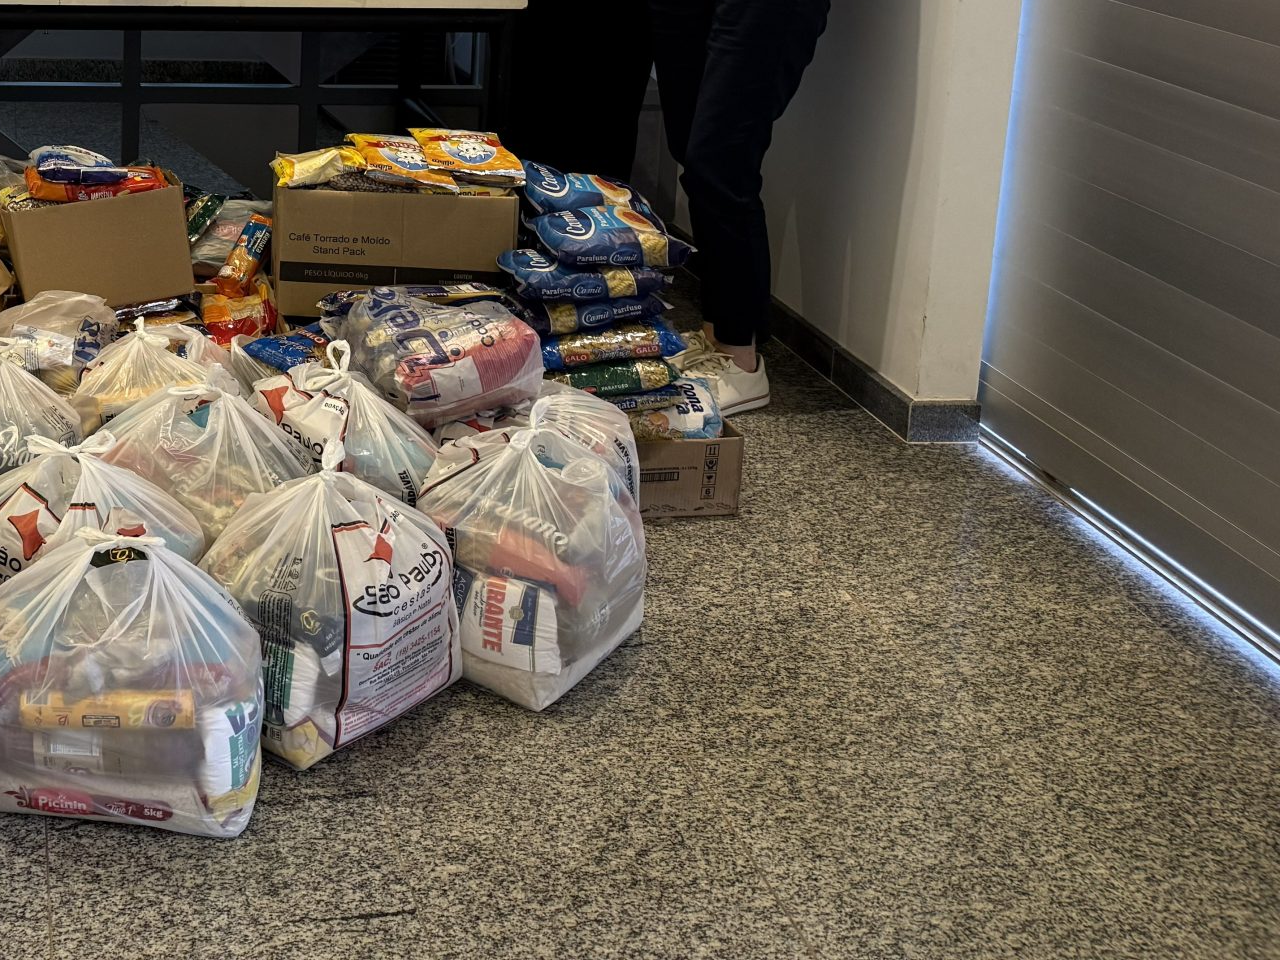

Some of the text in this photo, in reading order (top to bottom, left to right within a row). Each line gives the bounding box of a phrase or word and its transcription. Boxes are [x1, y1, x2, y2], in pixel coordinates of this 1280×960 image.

[288, 233, 311, 242] Café
[313, 233, 350, 244] Torrado
[361, 236, 391, 245] Moído
[312, 246, 366, 256] Stand Pack
[576, 254, 608, 262] Parafuso
[304, 269, 368, 280] PESO LÍQUIDO 6kg
[636, 346, 658, 354] GALO
[324, 402, 345, 416] DOAÇÃO
[393, 584, 432, 616] cestas
[39, 797, 86, 811] Picinin
[144, 807, 163, 819] 5kg
